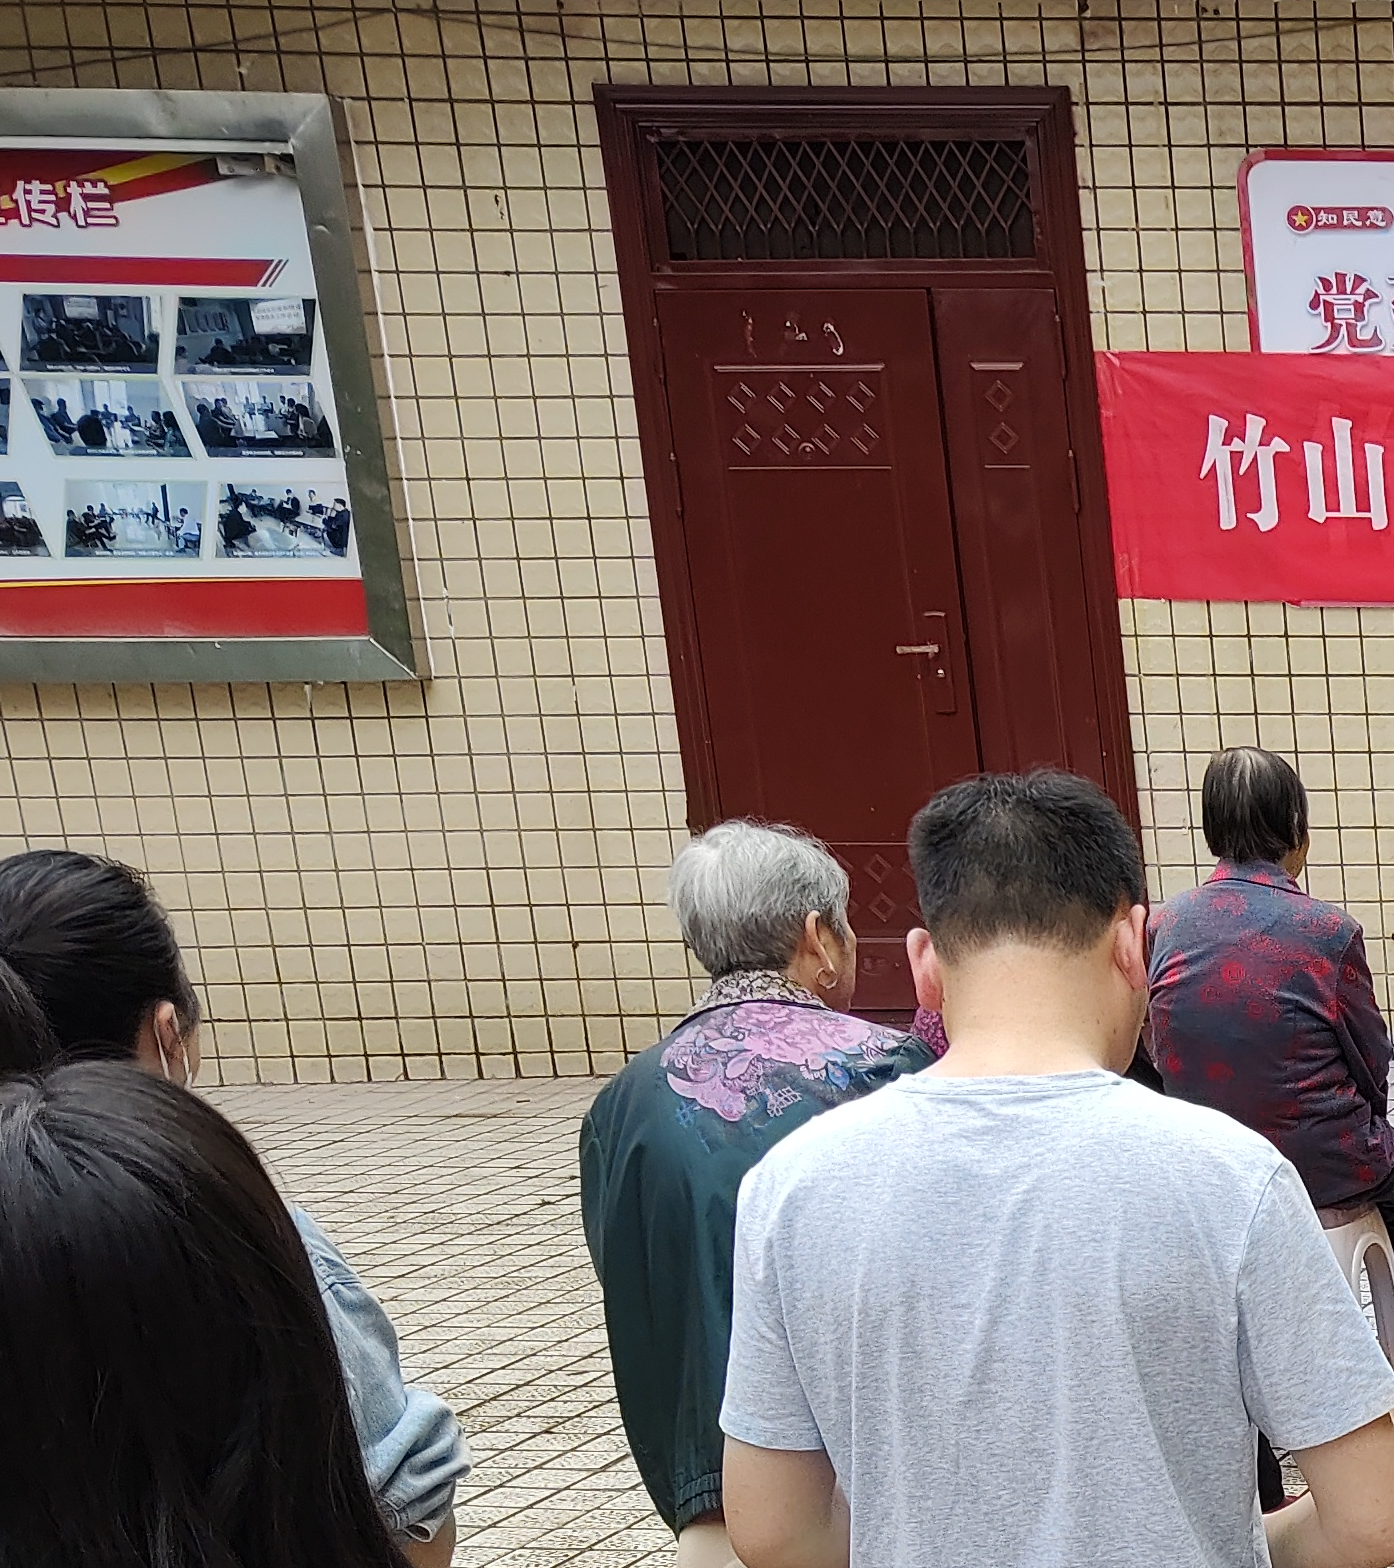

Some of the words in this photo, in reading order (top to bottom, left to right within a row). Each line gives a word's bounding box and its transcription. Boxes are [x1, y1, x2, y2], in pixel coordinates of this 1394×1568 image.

[0, 179, 119, 228] 传栏
[1317, 209, 1387, 227] 知民意
